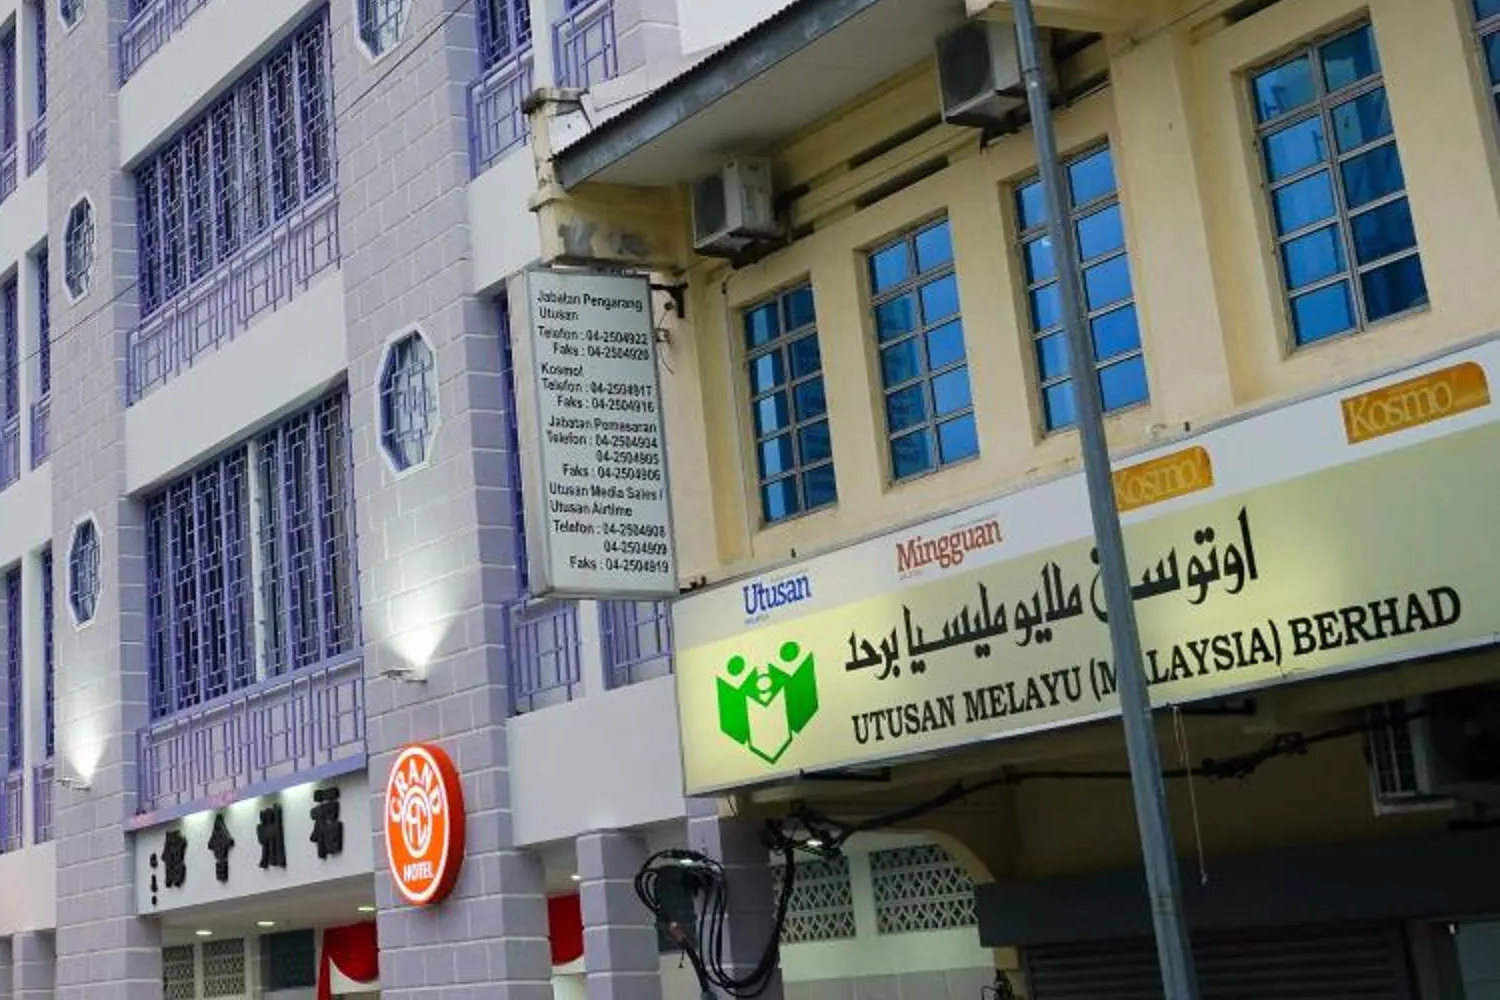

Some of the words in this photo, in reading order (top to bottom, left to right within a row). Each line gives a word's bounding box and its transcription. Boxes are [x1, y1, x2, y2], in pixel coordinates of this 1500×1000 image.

[537, 289, 581, 304] Jabatan
[583, 293, 643, 312] Pengarang
[539, 307, 579, 320] Utusan
[538, 325, 579, 341] Telefon
[553, 342, 579, 356] Faks
[541, 378, 582, 392] Telefon
[557, 395, 583, 408] Faks
[549, 416, 590, 429] Jabatan
[594, 418, 657, 433] Pemasaran
[546, 431, 586, 445] Telefon
[563, 464, 589, 477] Faks
[549, 482, 588, 495] Utusan
[591, 485, 624, 498] Media
[626, 486, 657, 500] Sales
[551, 500, 590, 513] Utusan
[592, 502, 633, 517] Airtime
[553, 520, 594, 534] Telefon
[896, 519, 1004, 574] Mingguan
[569, 556, 597, 570] Faks
[742, 573, 813, 615] Utusan
[852, 694, 957, 745] UTUSAN
[963, 665, 1083, 723] MELAYU
[1089, 619, 1282, 703] (MLAYSIA)
[1288, 585, 1462, 657] BERHAD
[390, 758, 443, 823] GRAND
[404, 861, 433, 882] HOTEL
